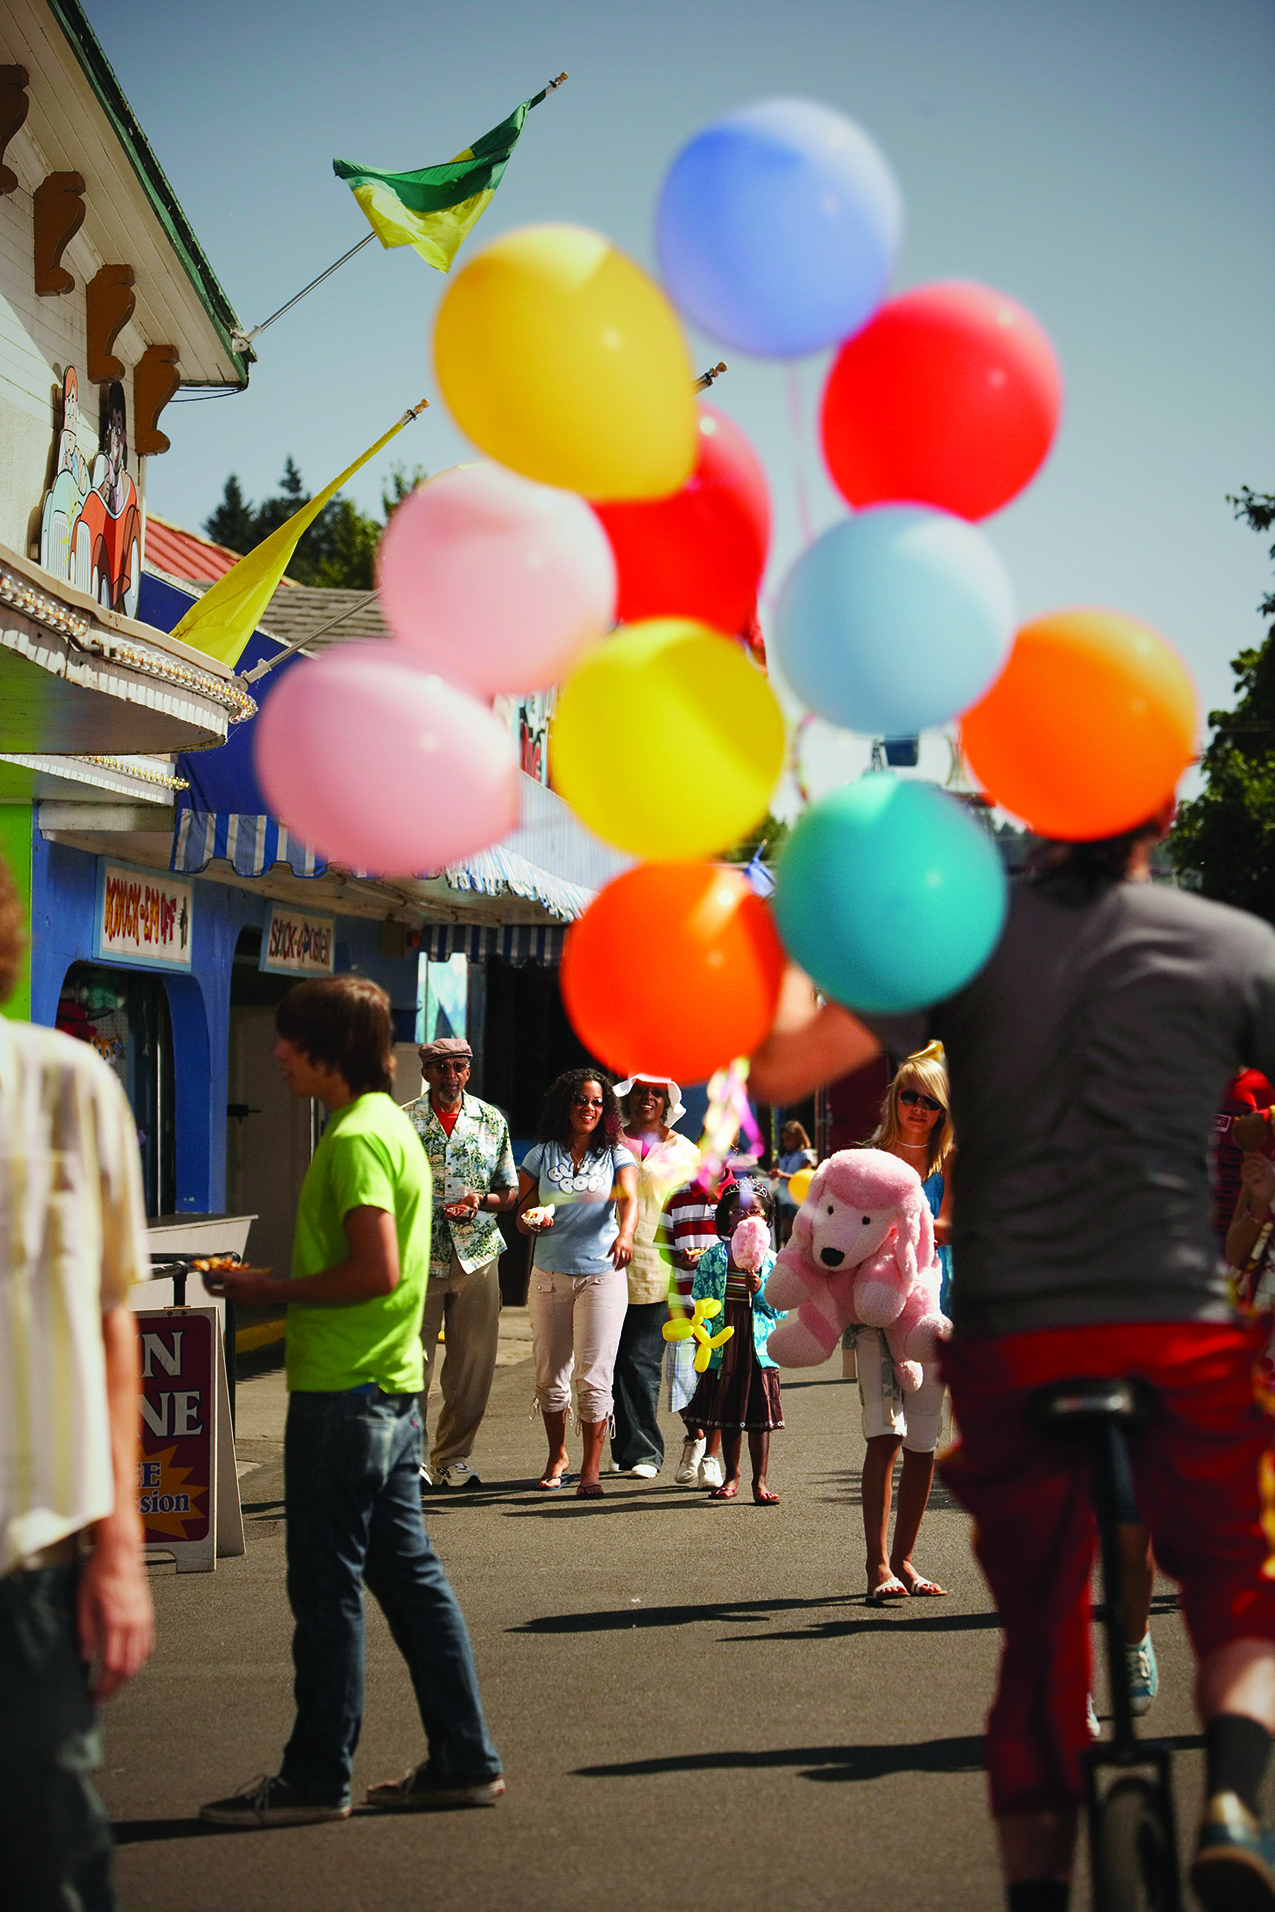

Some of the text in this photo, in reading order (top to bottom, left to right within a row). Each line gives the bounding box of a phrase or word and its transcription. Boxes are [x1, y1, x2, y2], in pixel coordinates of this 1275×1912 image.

[558, 1175, 605, 1195] POP
[138, 1331, 186, 1378] N
[137, 1490, 190, 1515] sion
